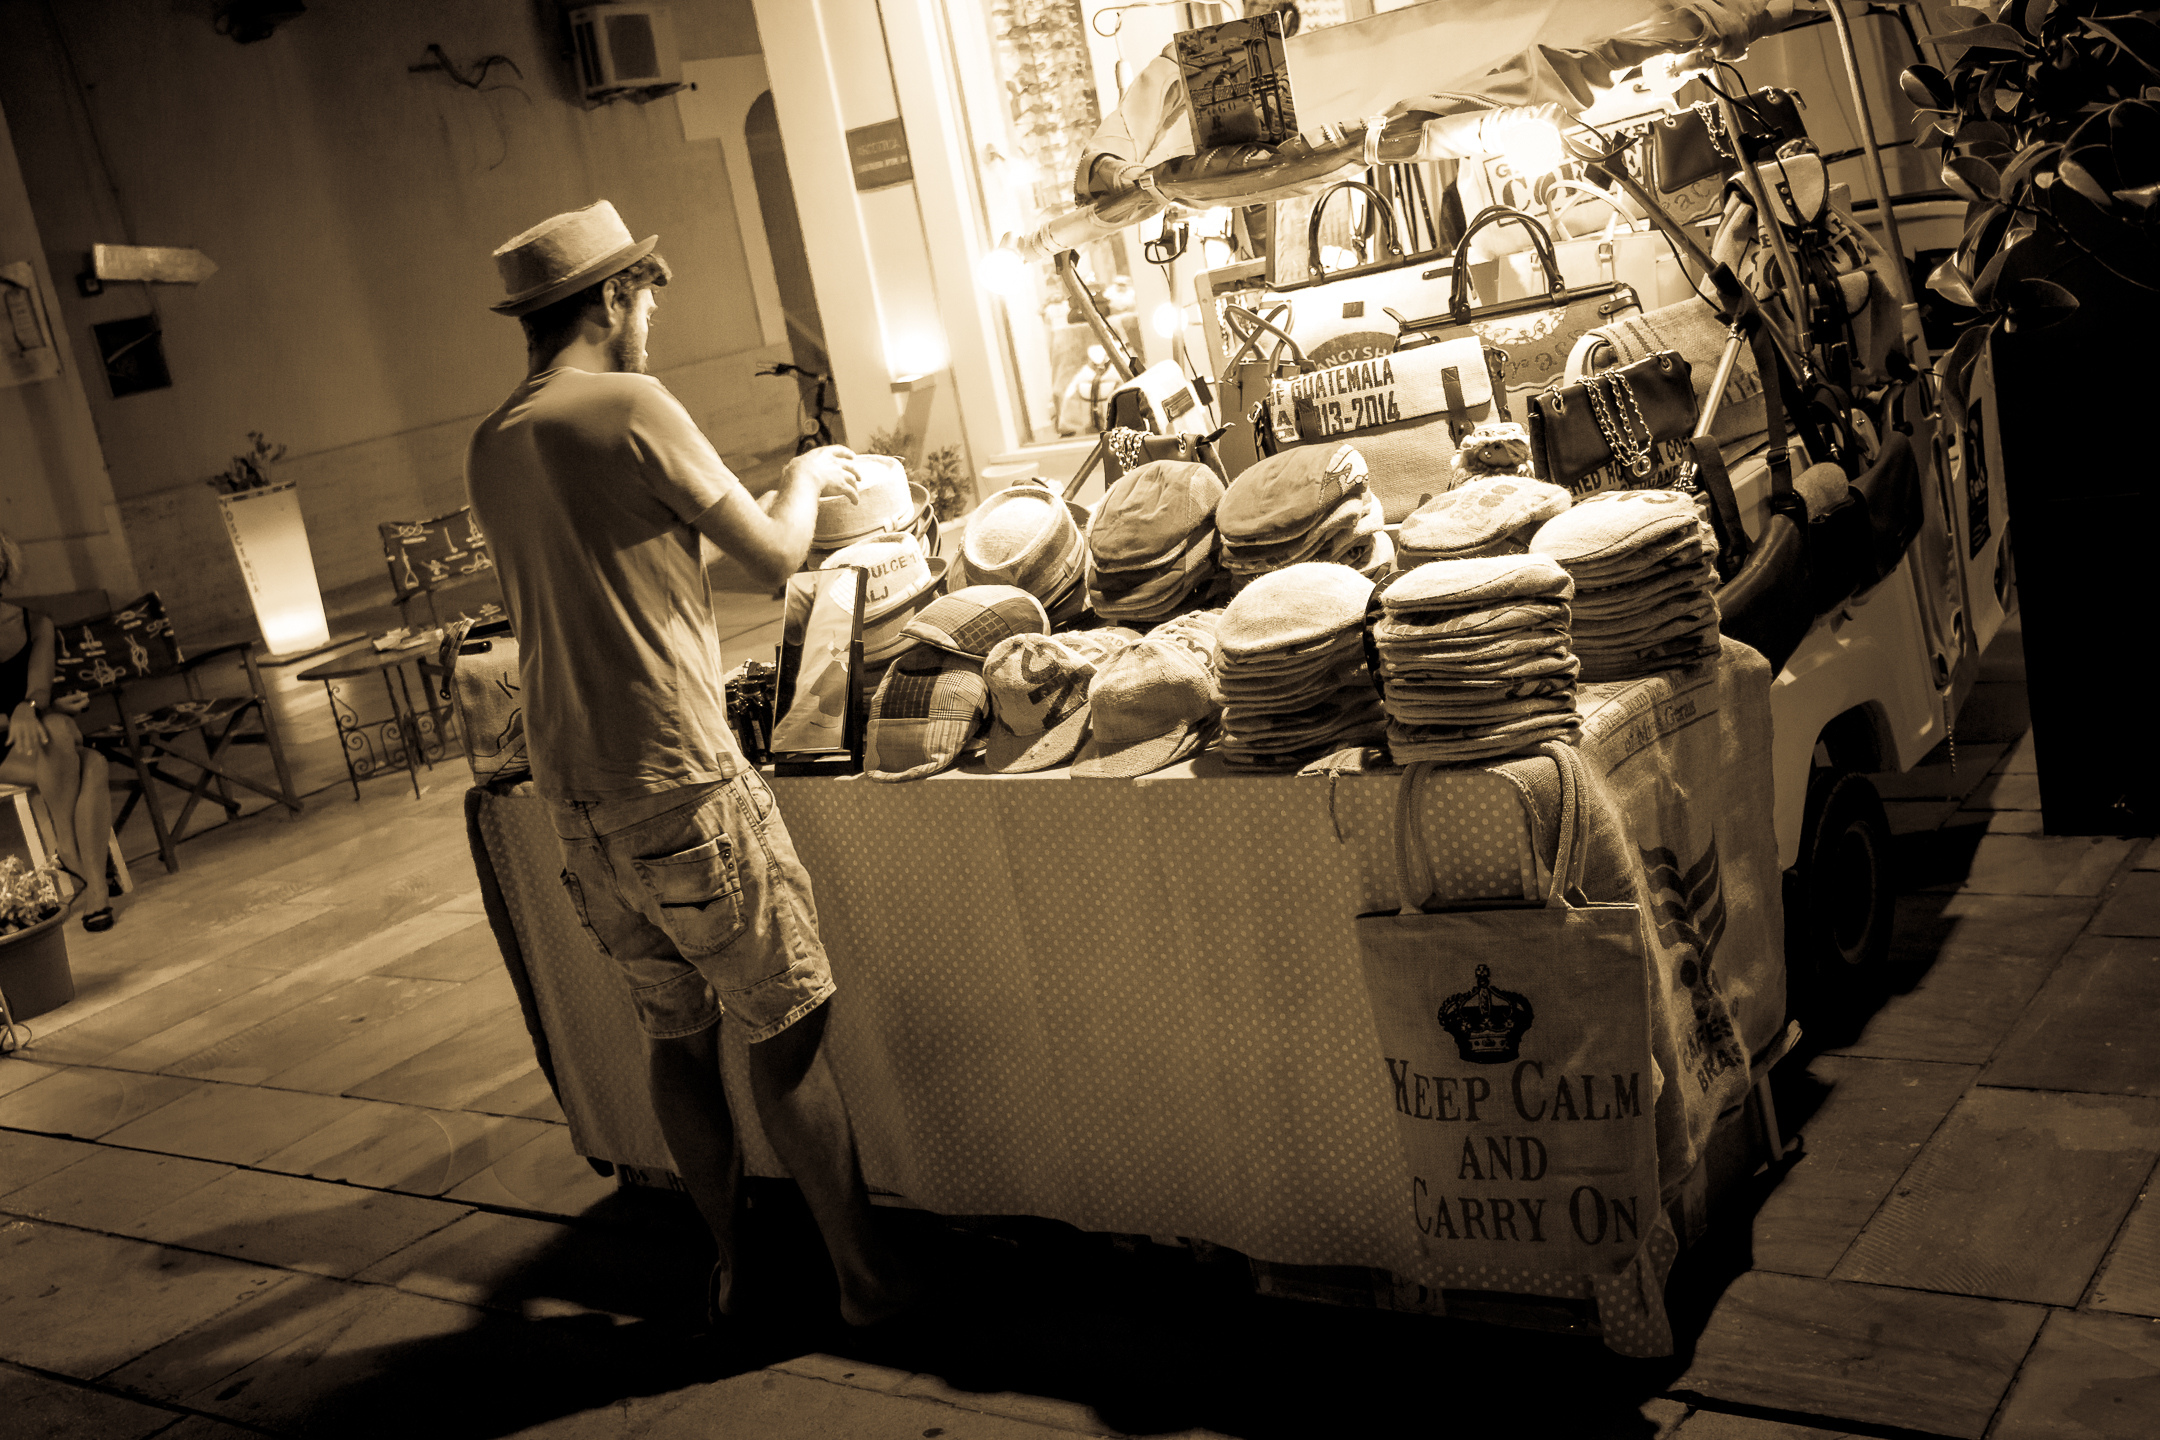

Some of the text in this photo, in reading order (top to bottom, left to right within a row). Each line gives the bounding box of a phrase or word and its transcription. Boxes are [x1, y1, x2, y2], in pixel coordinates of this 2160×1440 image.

[1291, 358, 1395, 401] GUATEMALA
[1385, 1057, 1643, 1123] KEEP CALM
[1457, 1135, 1548, 1181] AND
[1413, 1176, 1639, 1246] CARRY ON
